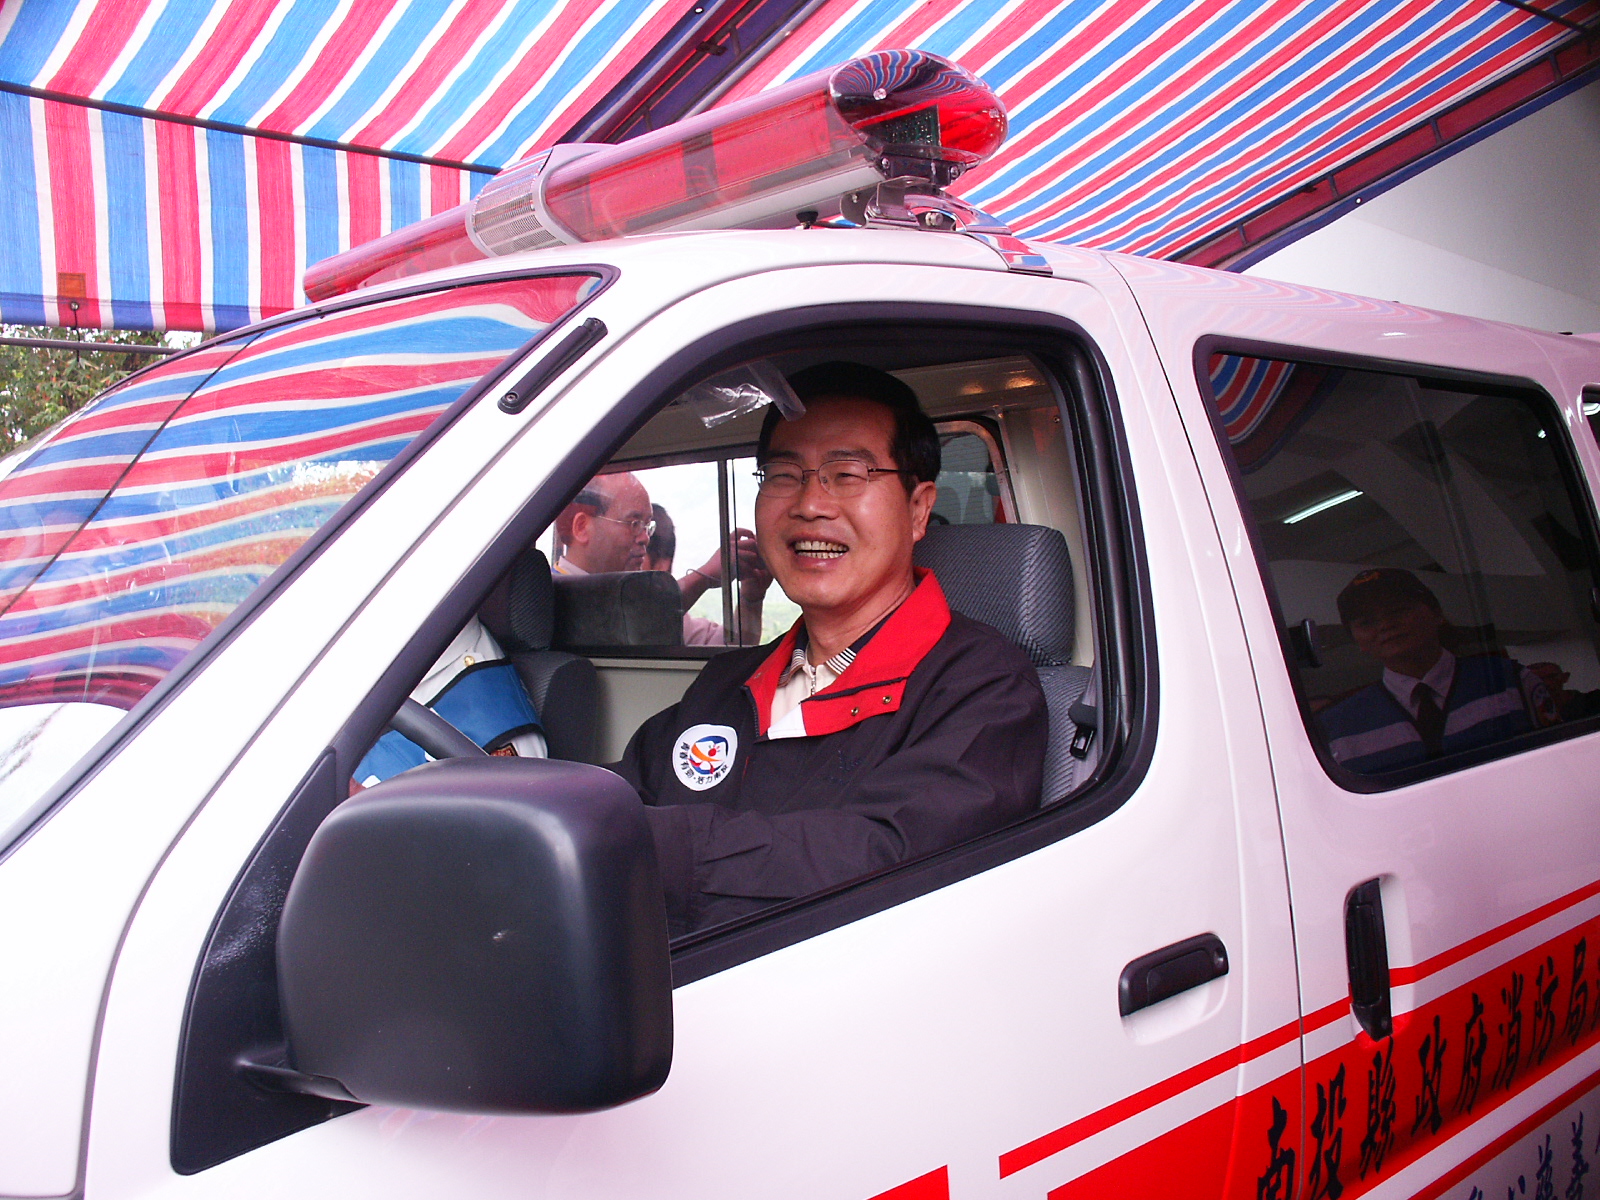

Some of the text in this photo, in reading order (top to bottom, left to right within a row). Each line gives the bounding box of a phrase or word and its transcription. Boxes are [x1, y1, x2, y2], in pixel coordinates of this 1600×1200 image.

[1257, 936, 1600, 1200] 南投縣政府消防局
